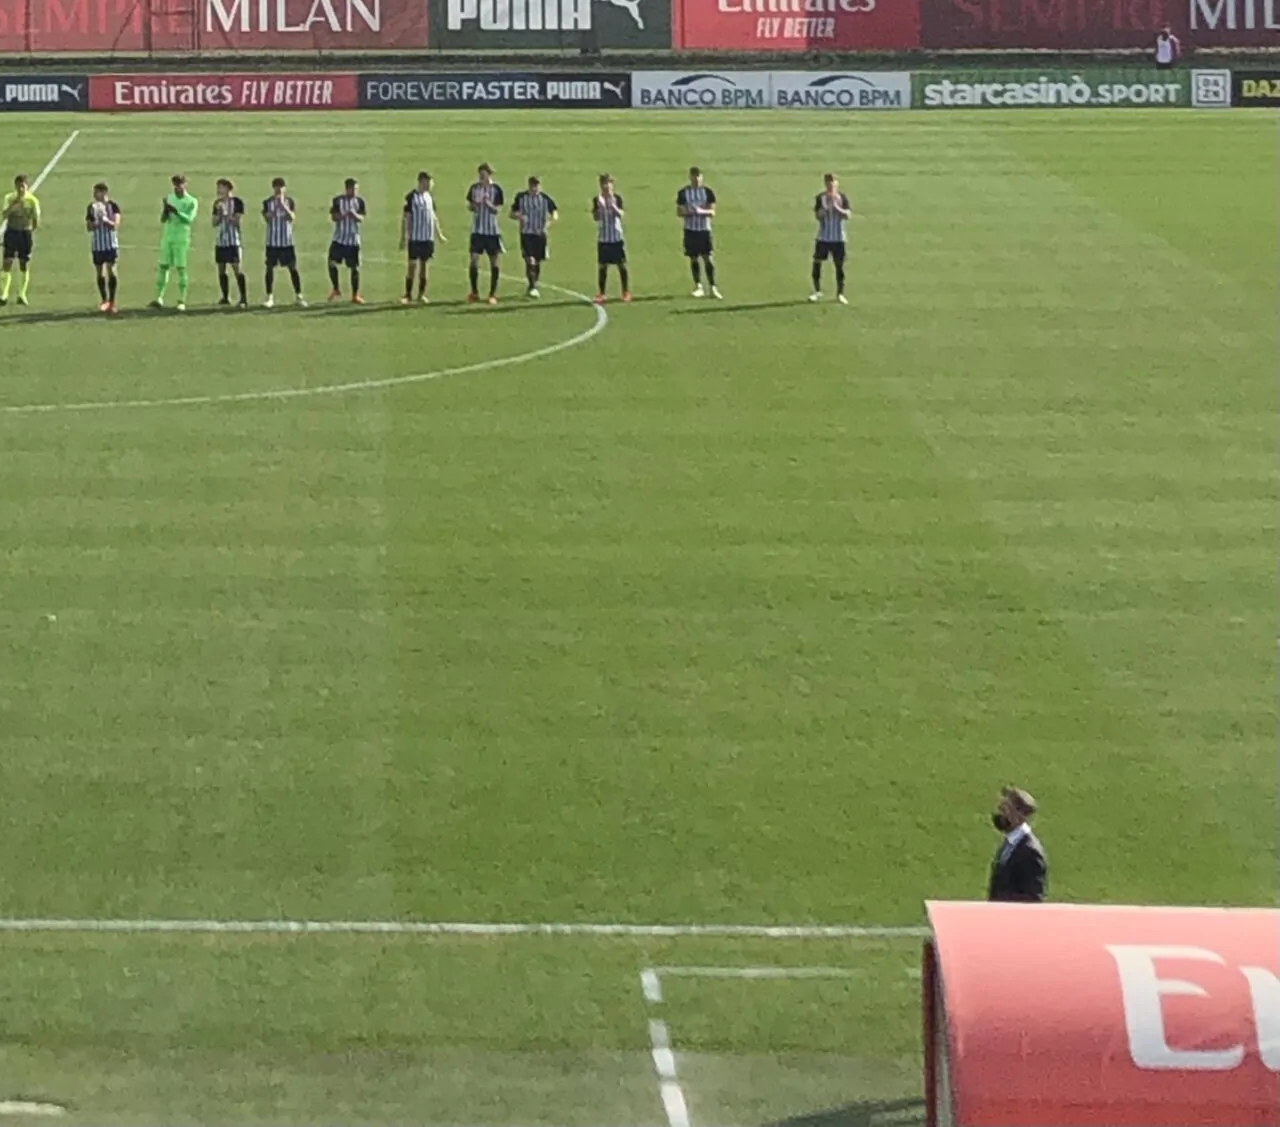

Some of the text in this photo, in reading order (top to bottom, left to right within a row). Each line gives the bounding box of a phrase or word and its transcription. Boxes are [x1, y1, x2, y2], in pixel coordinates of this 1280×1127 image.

[756, 17, 835, 39] FLY BETTER
[5, 83, 60, 102] PUMA
[114, 80, 333, 105] Emirates FLY BETTER
[546, 81, 601, 100] PUMA
[640, 88, 764, 106] BANCO BPM
[777, 90, 902, 107] BANCO BPM
